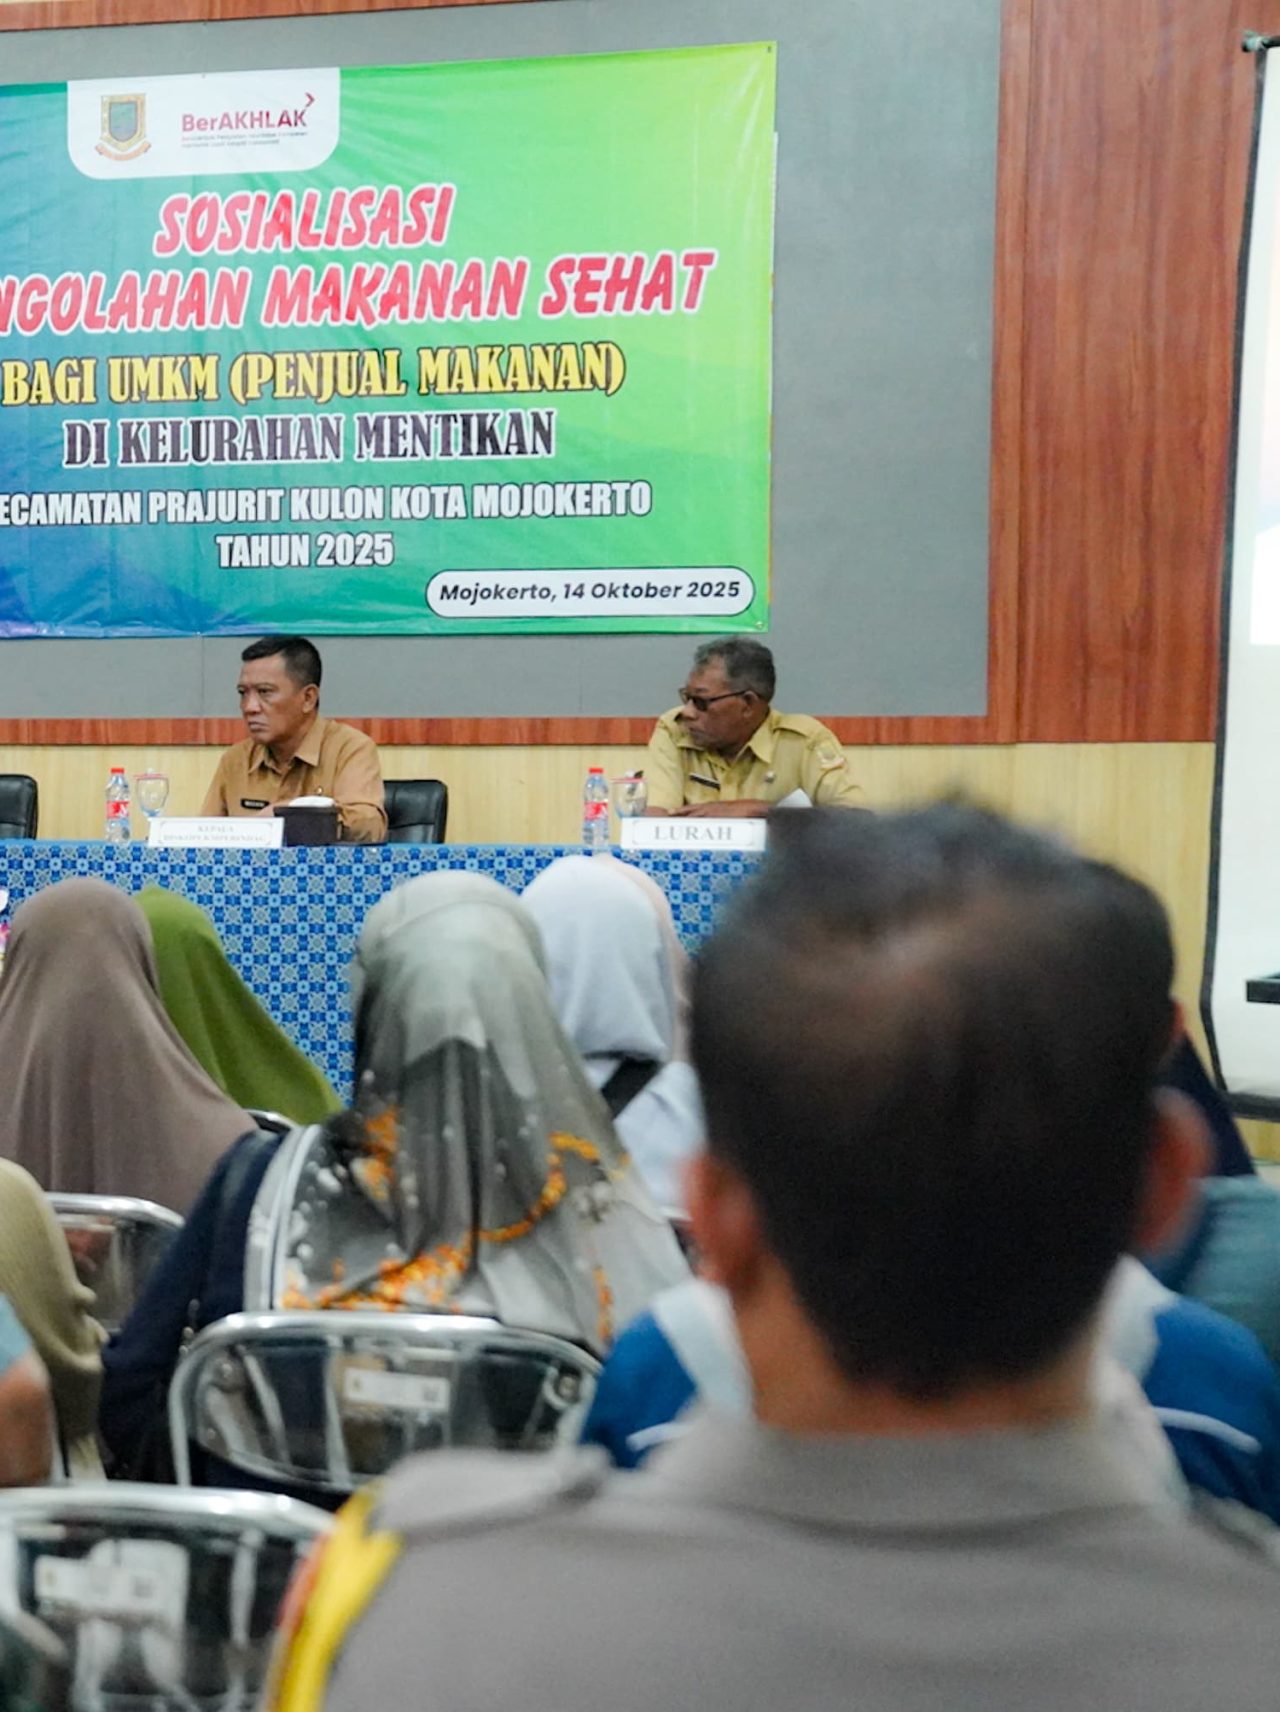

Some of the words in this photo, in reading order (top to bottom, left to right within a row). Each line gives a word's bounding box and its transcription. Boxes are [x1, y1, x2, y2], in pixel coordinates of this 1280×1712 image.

[182, 110, 306, 132] BerAKHLAK
[154, 183, 455, 256] SOSIALISASI
[261, 257, 529, 329] MAKANAN
[539, 248, 718, 317] SEHAT
[0, 356, 97, 406] BAGI
[108, 352, 219, 403] UMKM
[229, 348, 407, 404] (PENJUAL
[418, 342, 626, 395] MAKANAN)
[62, 418, 110, 468] DI
[117, 413, 343, 466] KELURAHAN
[354, 408, 557, 461] MENTIKAN
[148, 488, 285, 525] PRAJURIT
[290, 486, 384, 521] KULON
[390, 484, 467, 520] KOTA
[472, 480, 652, 518] MOJOKERTO
[215, 534, 310, 568] TAHUN
[316, 532, 394, 567] 2025
[439, 583, 557, 606] Mojokerto,
[562, 583, 585, 600] 14
[591, 581, 682, 600] Oktober
[686, 581, 741, 599] 2025
[654, 825, 733, 841] LURAH
